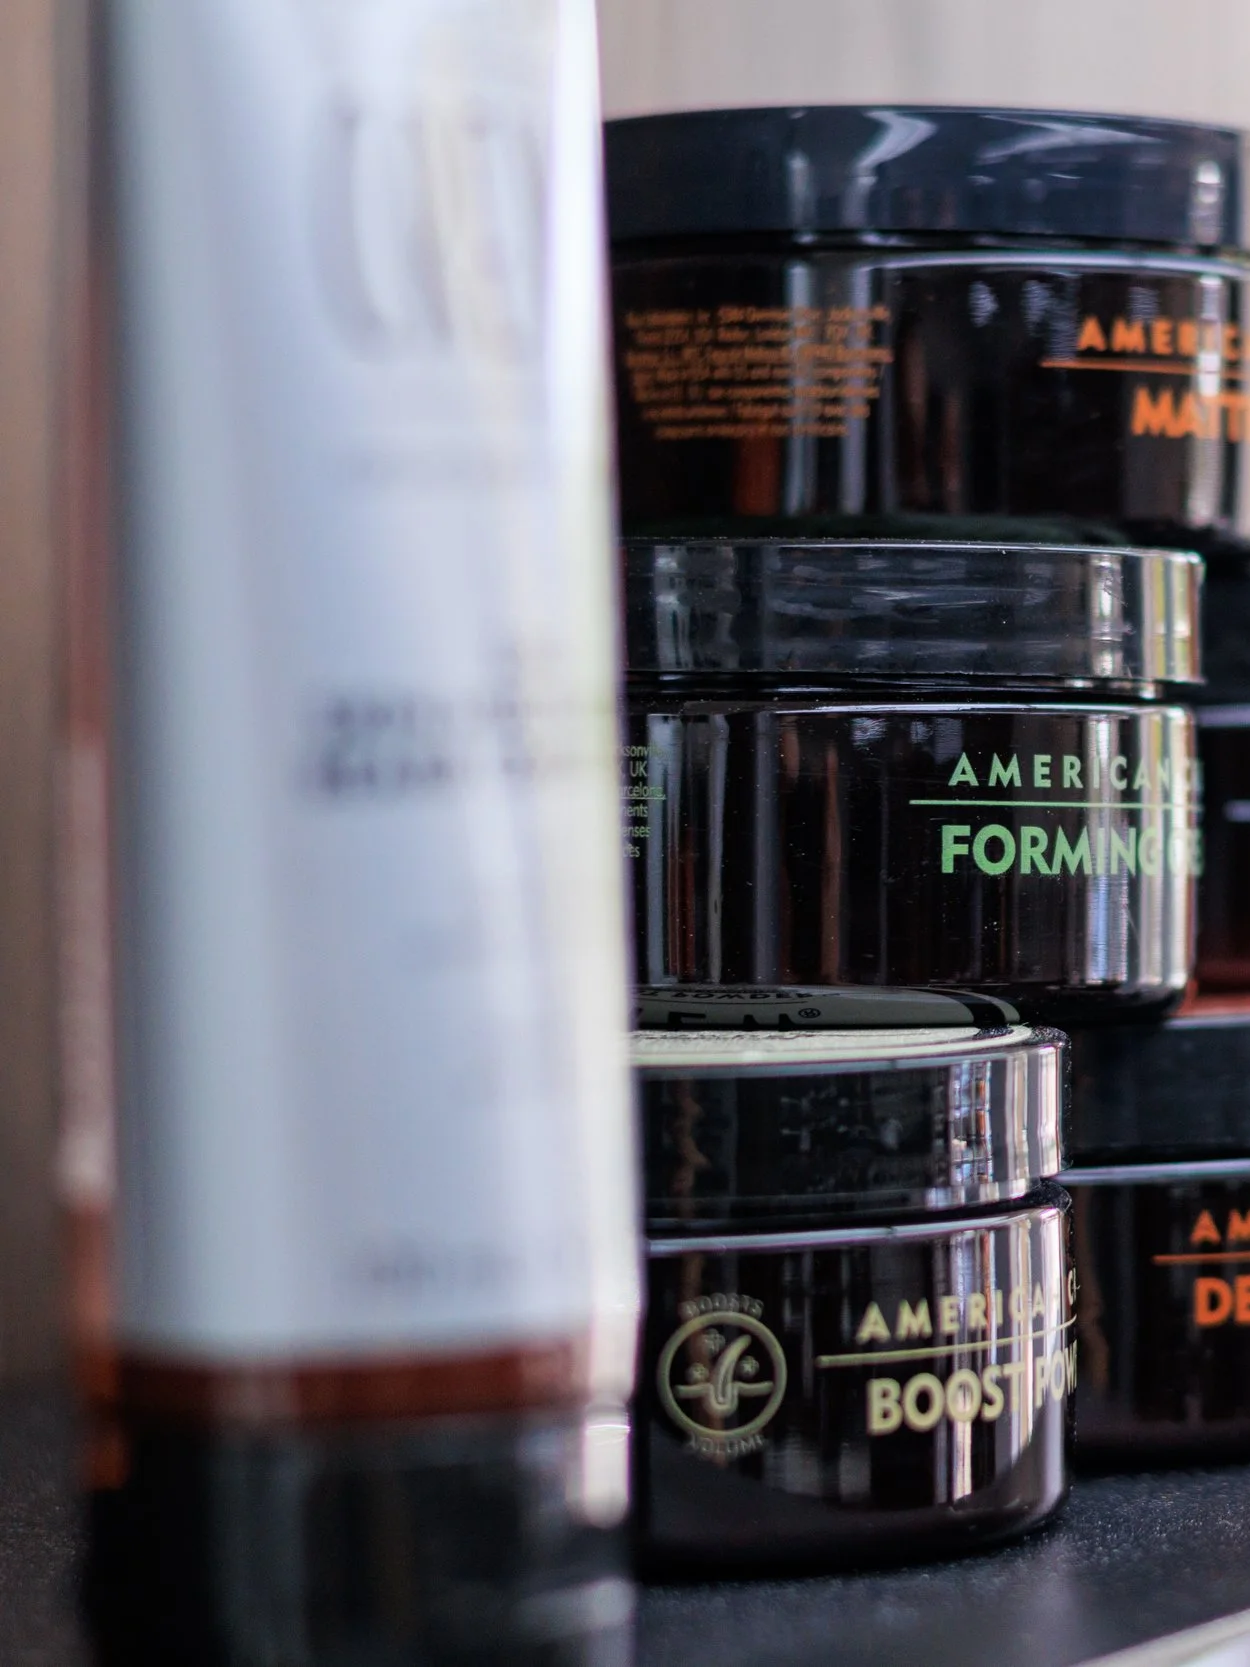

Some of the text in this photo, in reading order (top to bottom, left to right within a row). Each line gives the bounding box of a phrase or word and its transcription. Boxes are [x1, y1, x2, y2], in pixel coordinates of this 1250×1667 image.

[947, 752, 1171, 790] AMERICAN
[940, 823, 1162, 878] FORMING
[855, 1276, 1060, 1345] AMERICA
[866, 1339, 1078, 1437] BOOST POW
